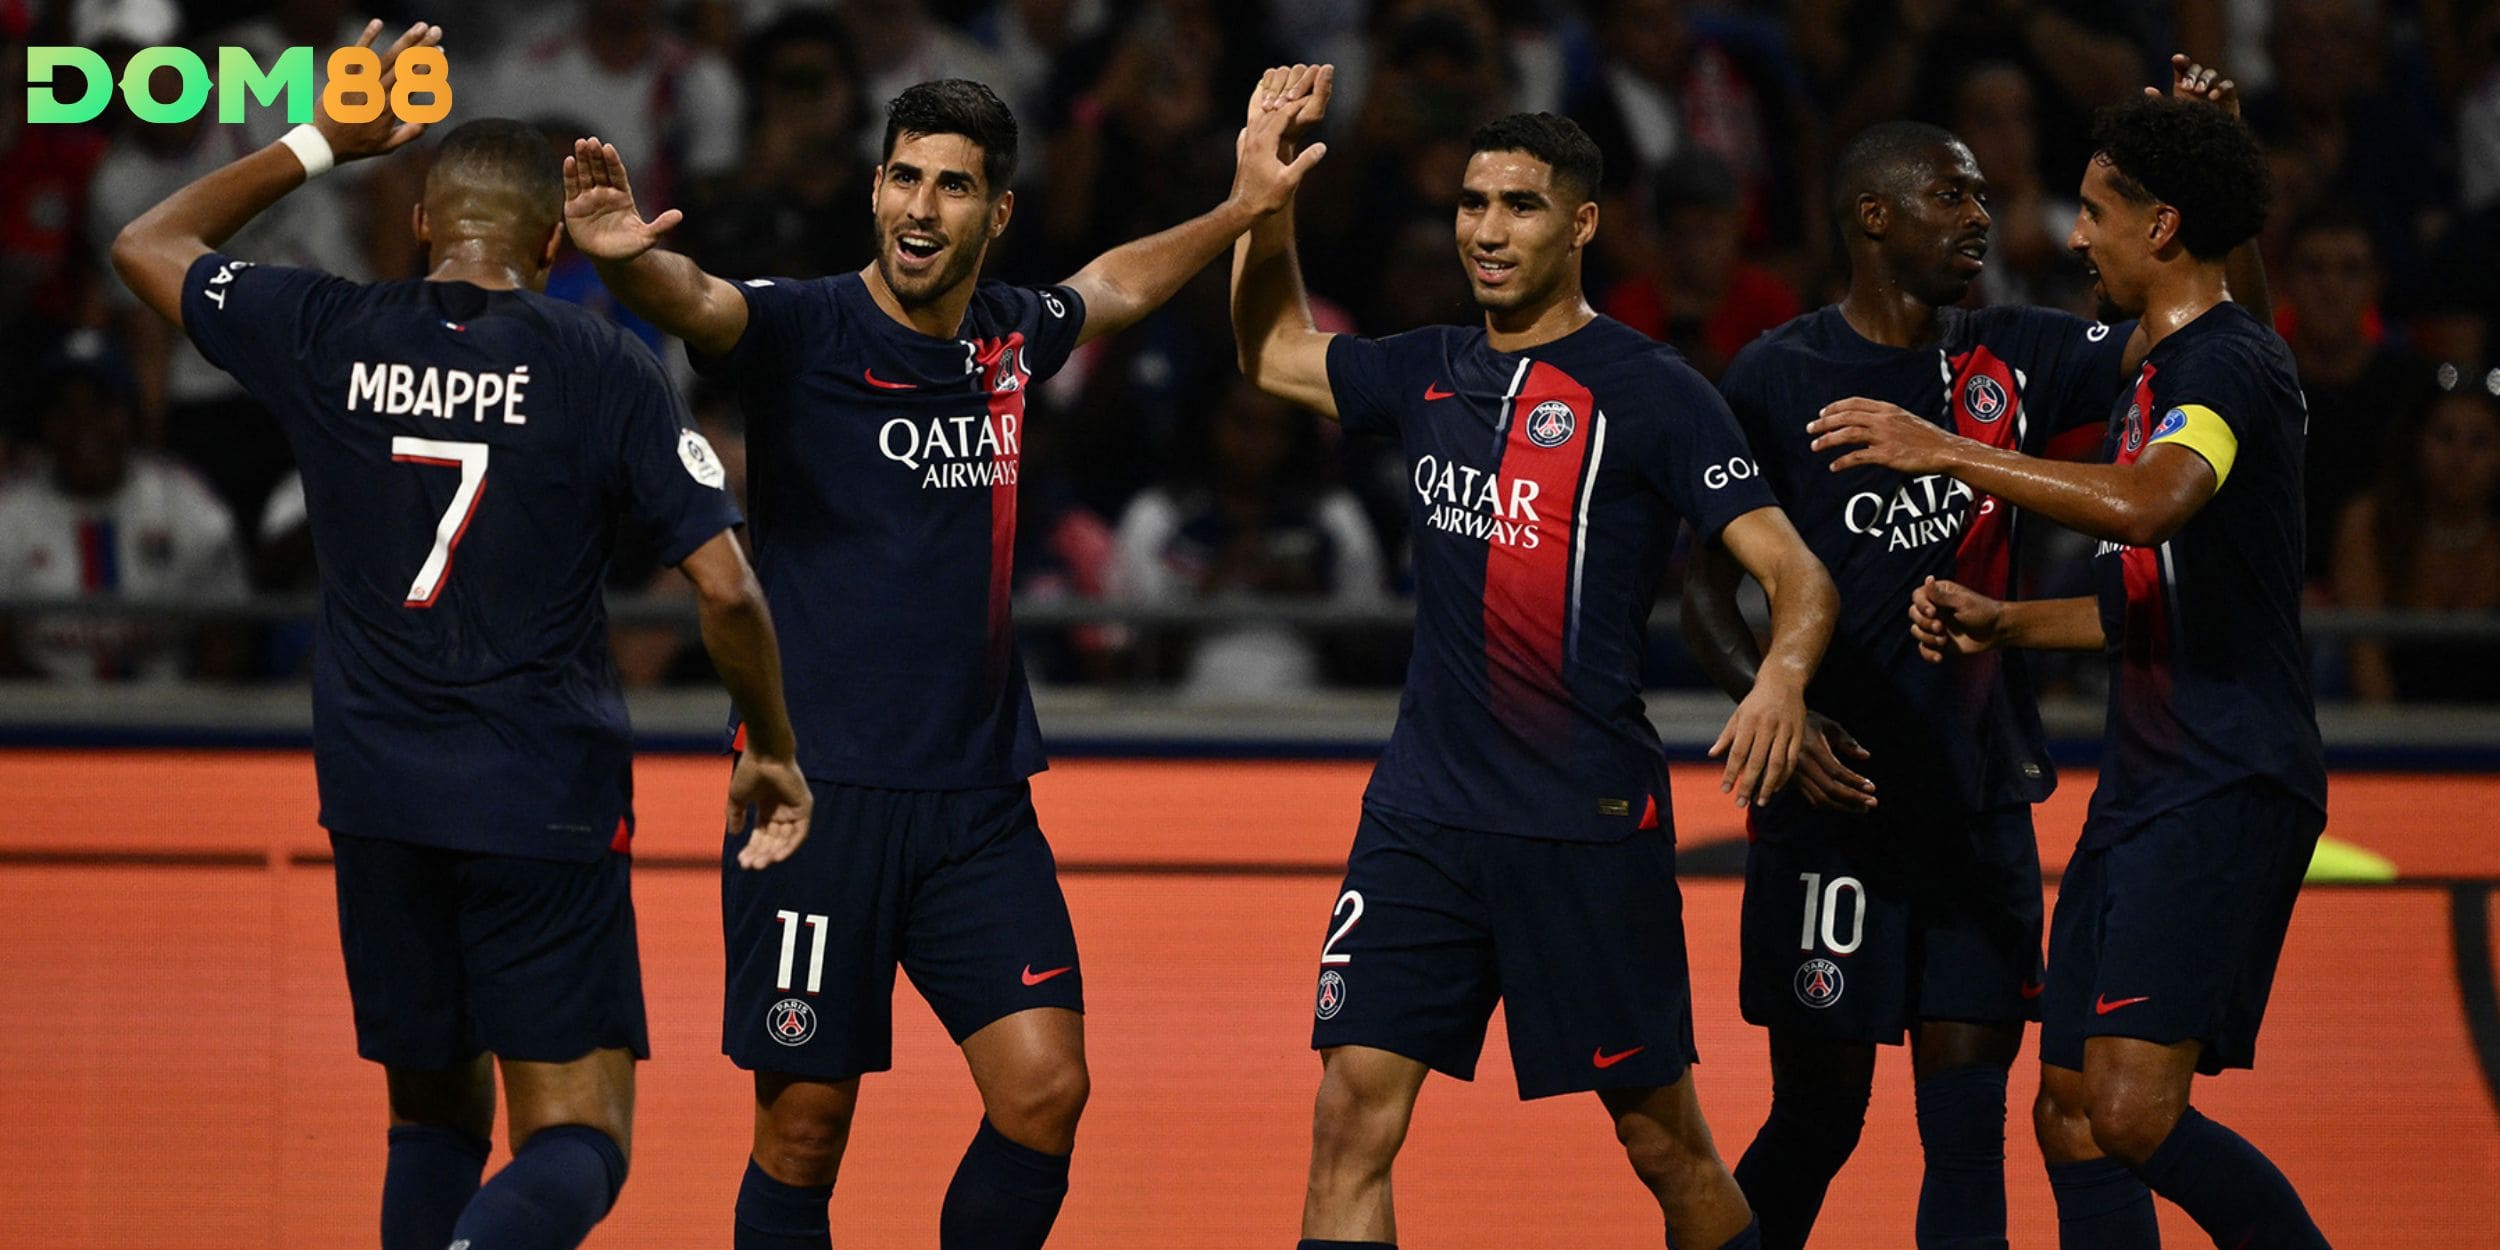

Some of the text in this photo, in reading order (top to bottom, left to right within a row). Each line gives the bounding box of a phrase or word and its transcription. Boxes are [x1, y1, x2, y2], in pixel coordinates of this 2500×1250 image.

[347, 362, 530, 425] MBAPPÉ
[879, 414, 1019, 470] QATAR
[922, 459, 1017, 489] AIRWAYS
[1415, 454, 1540, 521] QATAR
[1844, 474, 1974, 538] QATA
[391, 436, 489, 608] 7
[1427, 504, 1540, 549] AIRWAYS
[1321, 890, 1364, 967] 2
[1800, 872, 1866, 957] 10
[776, 909, 829, 996] 11
